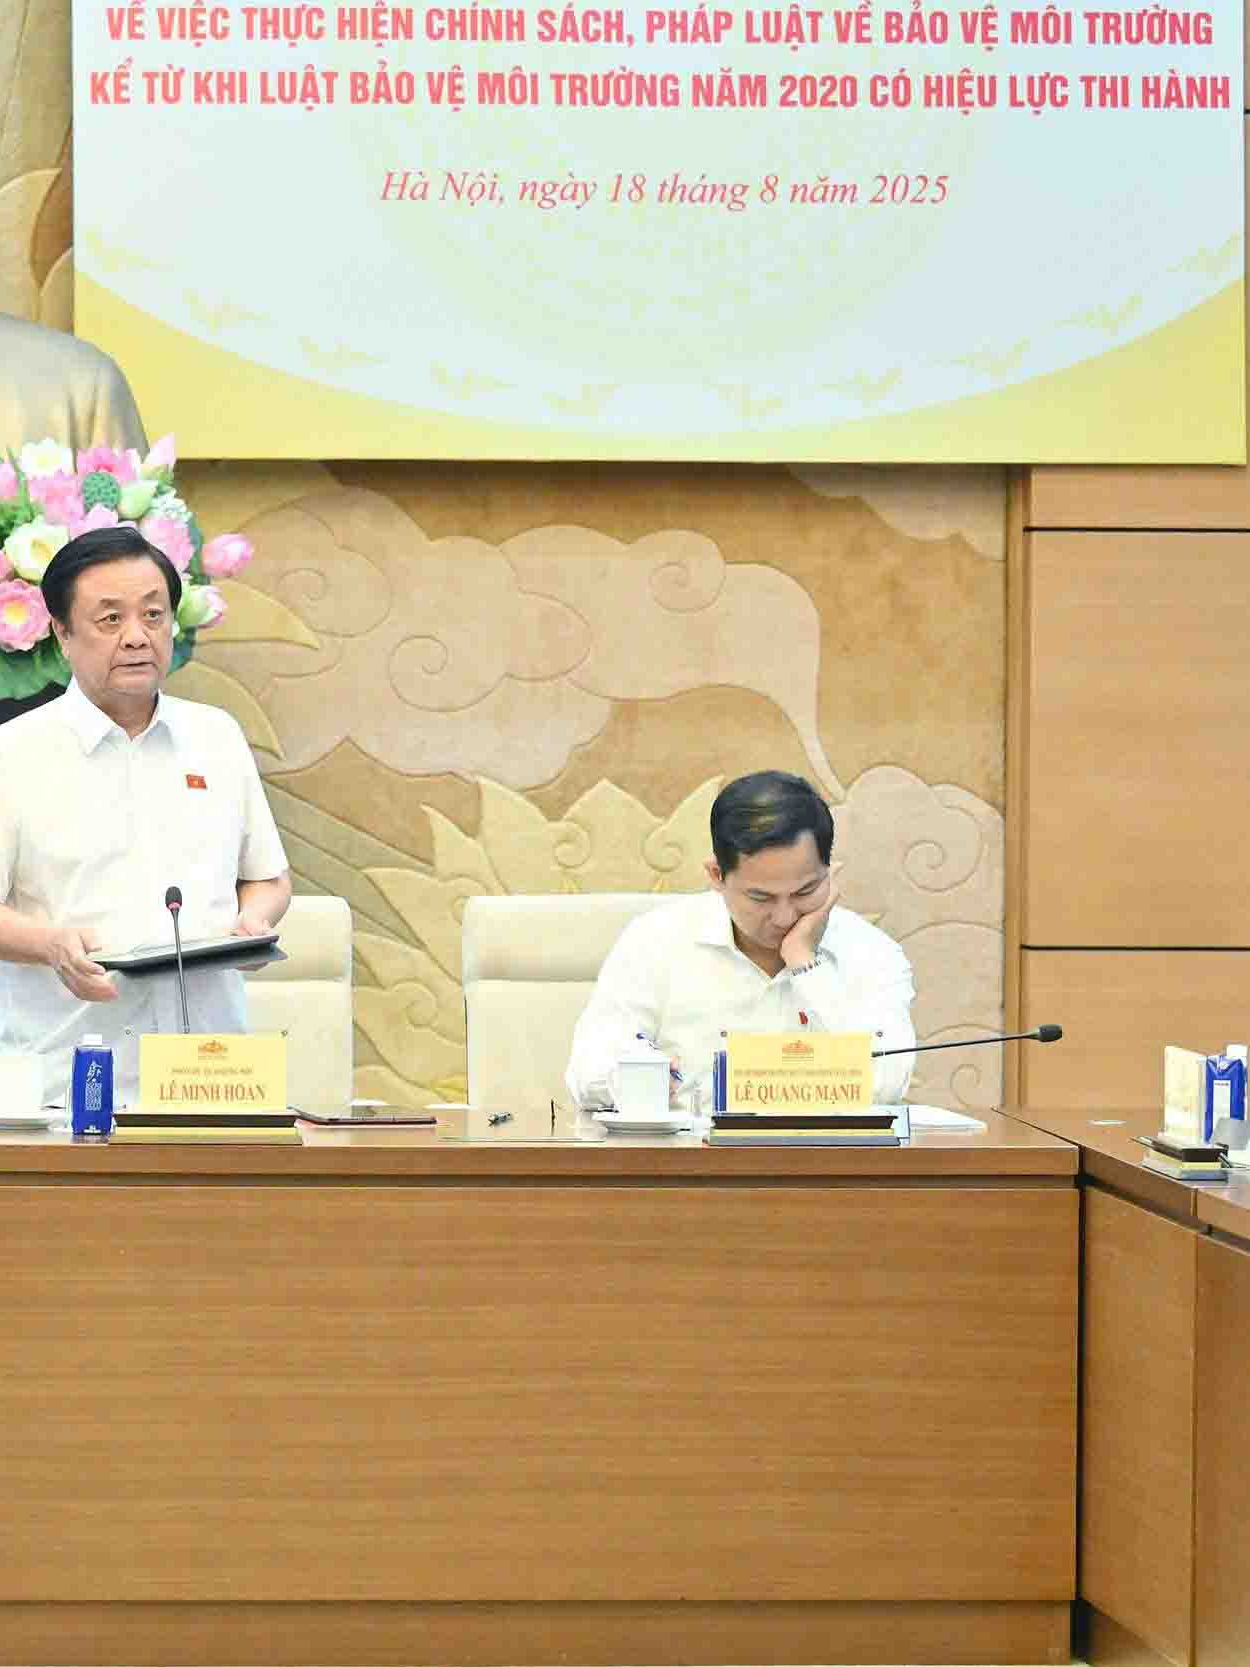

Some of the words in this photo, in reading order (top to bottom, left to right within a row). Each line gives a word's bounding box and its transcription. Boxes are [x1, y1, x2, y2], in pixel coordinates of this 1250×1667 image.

[156, 0, 230, 47] VIỆC
[241, 4, 325, 47] THỰC
[337, 1, 414, 47] HIỆN
[425, 2, 525, 41] CHÍNH
[537, 3, 634, 47] SÁCH,
[645, 4, 733, 43] PHÁP
[745, 4, 823, 51] LUẬT
[834, 0, 872, 43] VỀ
[884, 0, 948, 43] BẢO
[960, 5, 998, 51] VỆ
[1010, 5, 1072, 44] MÔI
[1084, 4, 1213, 45] TRƯỜNG
[90, 57, 133, 104] KỂ
[142, 64, 185, 104] TỪ
[193, 72, 247, 104] KHI
[260, 64, 338, 111] LUẬT
[350, 60, 414, 104] BẢO
[427, 64, 465, 112] VỆ
[478, 65, 538, 104] MÔI
[550, 66, 679, 107] TRƯỜNG
[692, 67, 767, 107] NĂM
[779, 74, 858, 107] 2020
[869, 68, 911, 107] CÓ
[924, 68, 997, 115] HIỆU
[1009, 72, 1068, 115] LỰC
[1079, 75, 1130, 108] THI
[1142, 69, 1230, 109] HÀNH
[380, 171, 431, 201] Hà
[438, 170, 506, 206] Nội,
[518, 172, 598, 210] ngày
[609, 173, 647, 203] 18
[657, 172, 750, 211] tháng
[759, 174, 779, 203] 8
[790, 175, 858, 204] năm
[870, 174, 950, 204] 2025
[181, 1084, 221, 1100] MINH
[758, 1084, 811, 1104] QUANG
[815, 1083, 862, 1104] MẠNH
